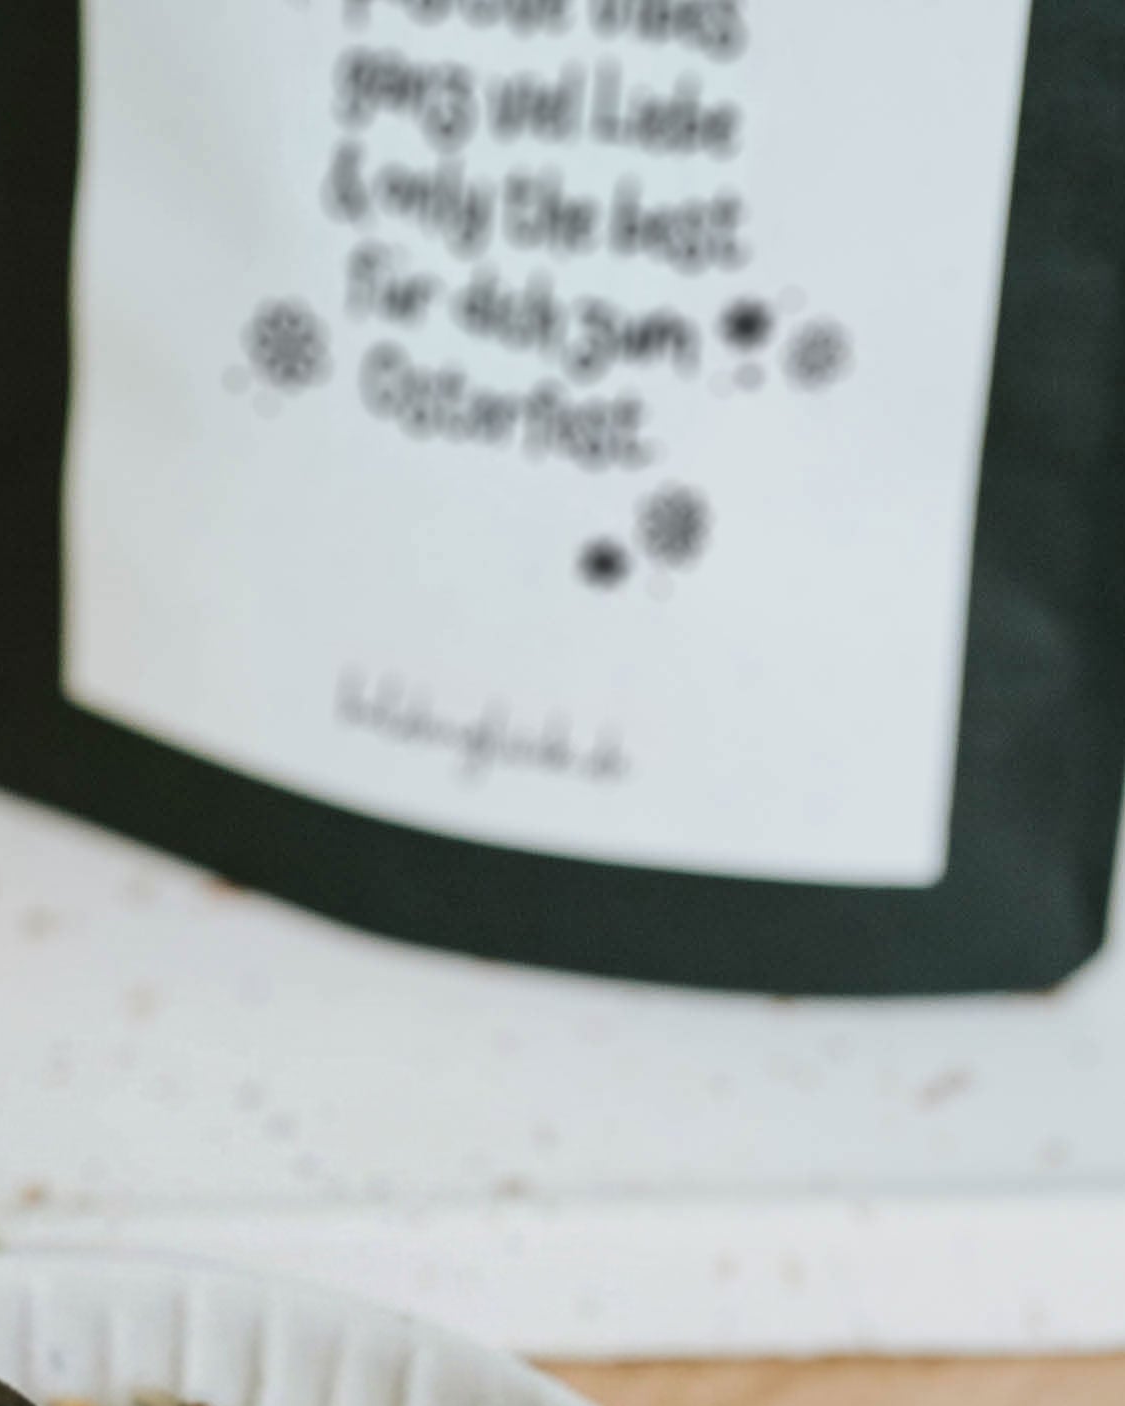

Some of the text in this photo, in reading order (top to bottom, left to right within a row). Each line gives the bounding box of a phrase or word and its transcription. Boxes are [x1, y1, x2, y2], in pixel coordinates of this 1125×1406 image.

[593, 57, 740, 158] Liebe
[376, 158, 490, 259] only
[504, 166, 596, 254] the
[611, 174, 748, 273] best
[451, 266, 565, 360] dich
[562, 298, 700, 384] zum
